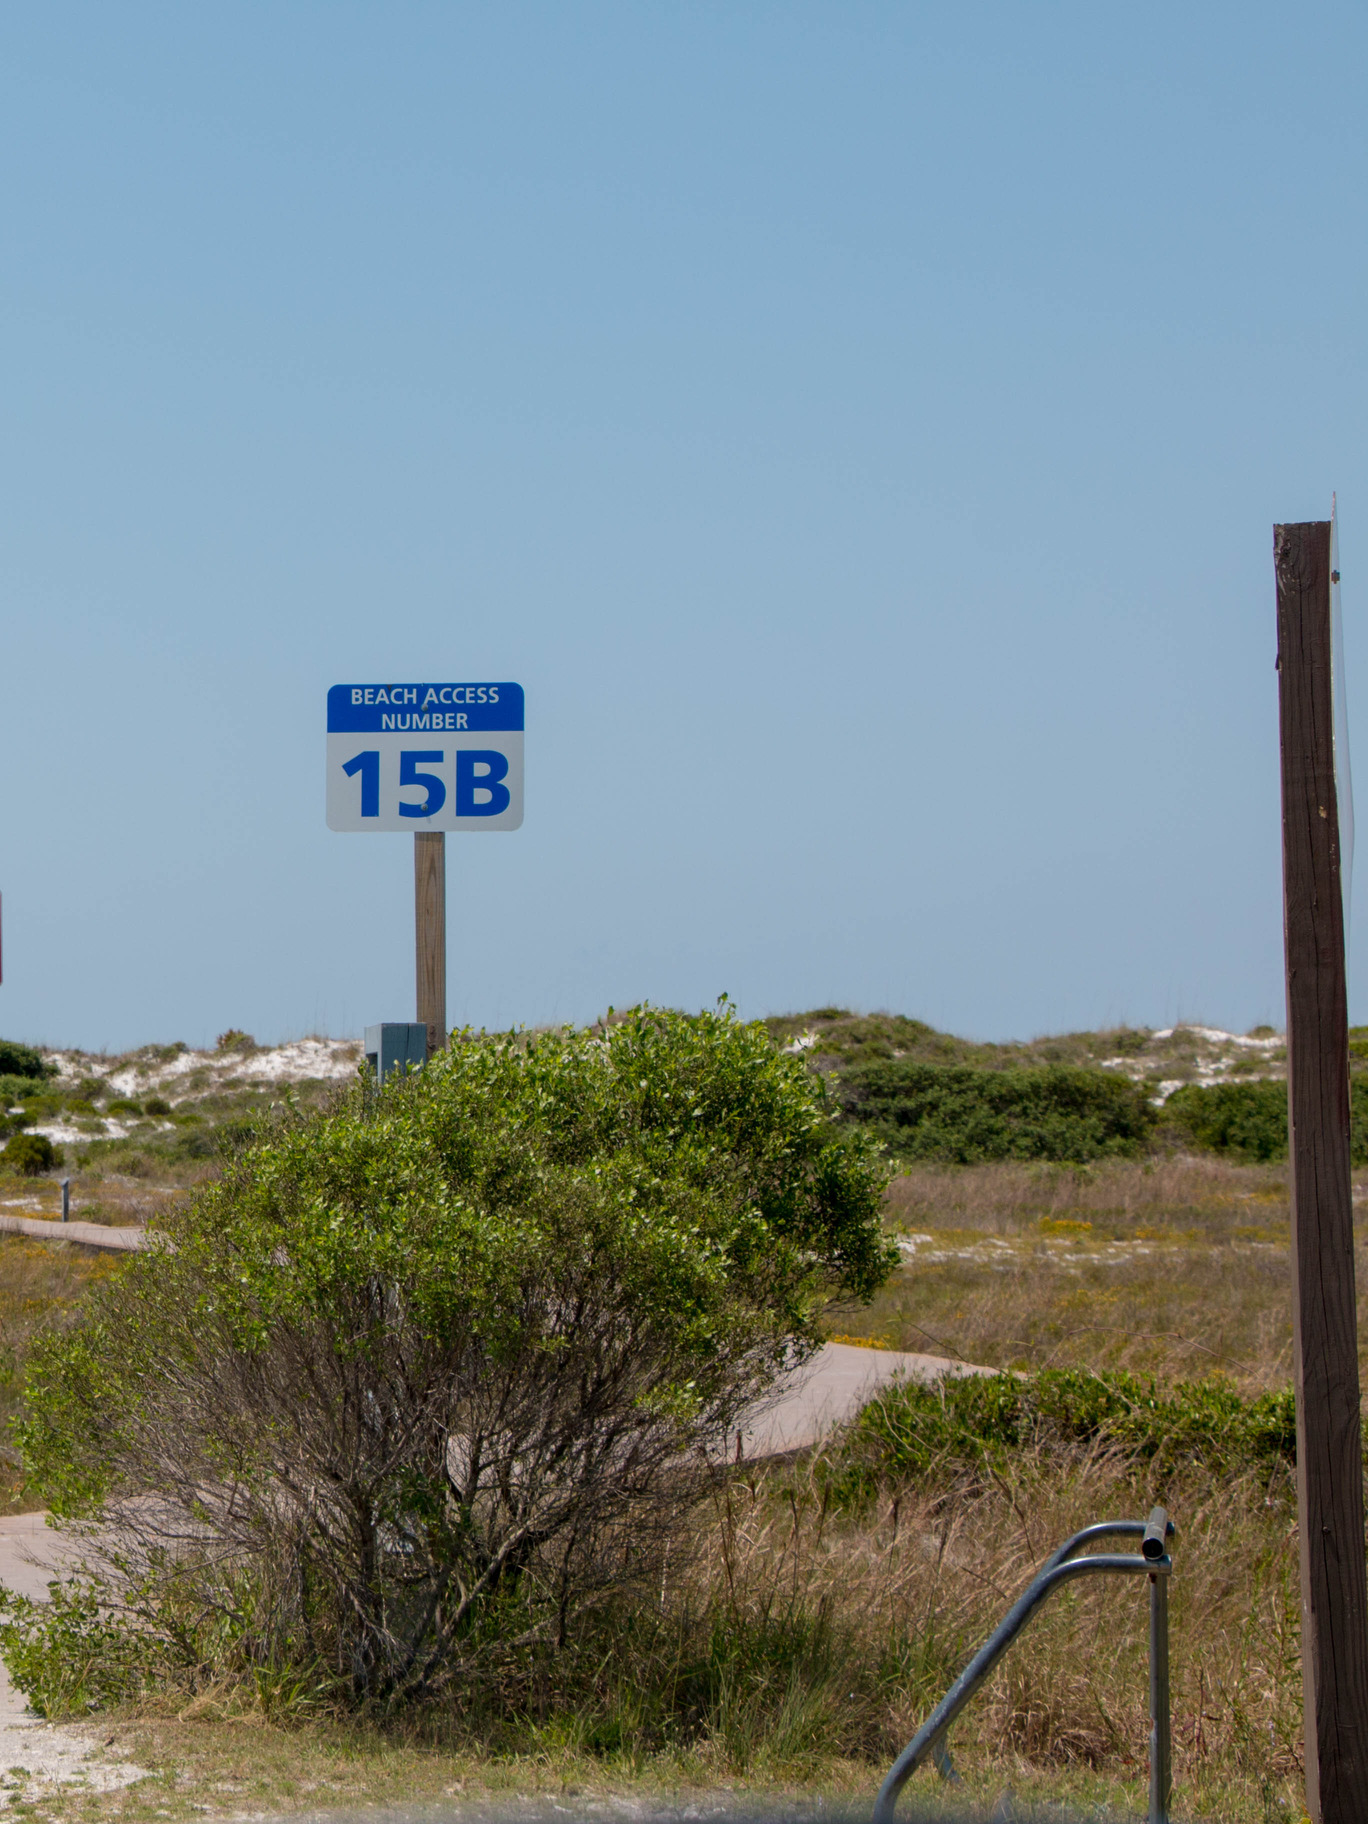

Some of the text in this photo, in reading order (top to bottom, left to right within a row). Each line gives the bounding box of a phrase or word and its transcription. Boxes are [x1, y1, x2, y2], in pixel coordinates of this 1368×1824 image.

[351, 687, 500, 705] BEACH ACCESS
[382, 713, 468, 730] NUMBER
[341, 750, 511, 818] 15B
